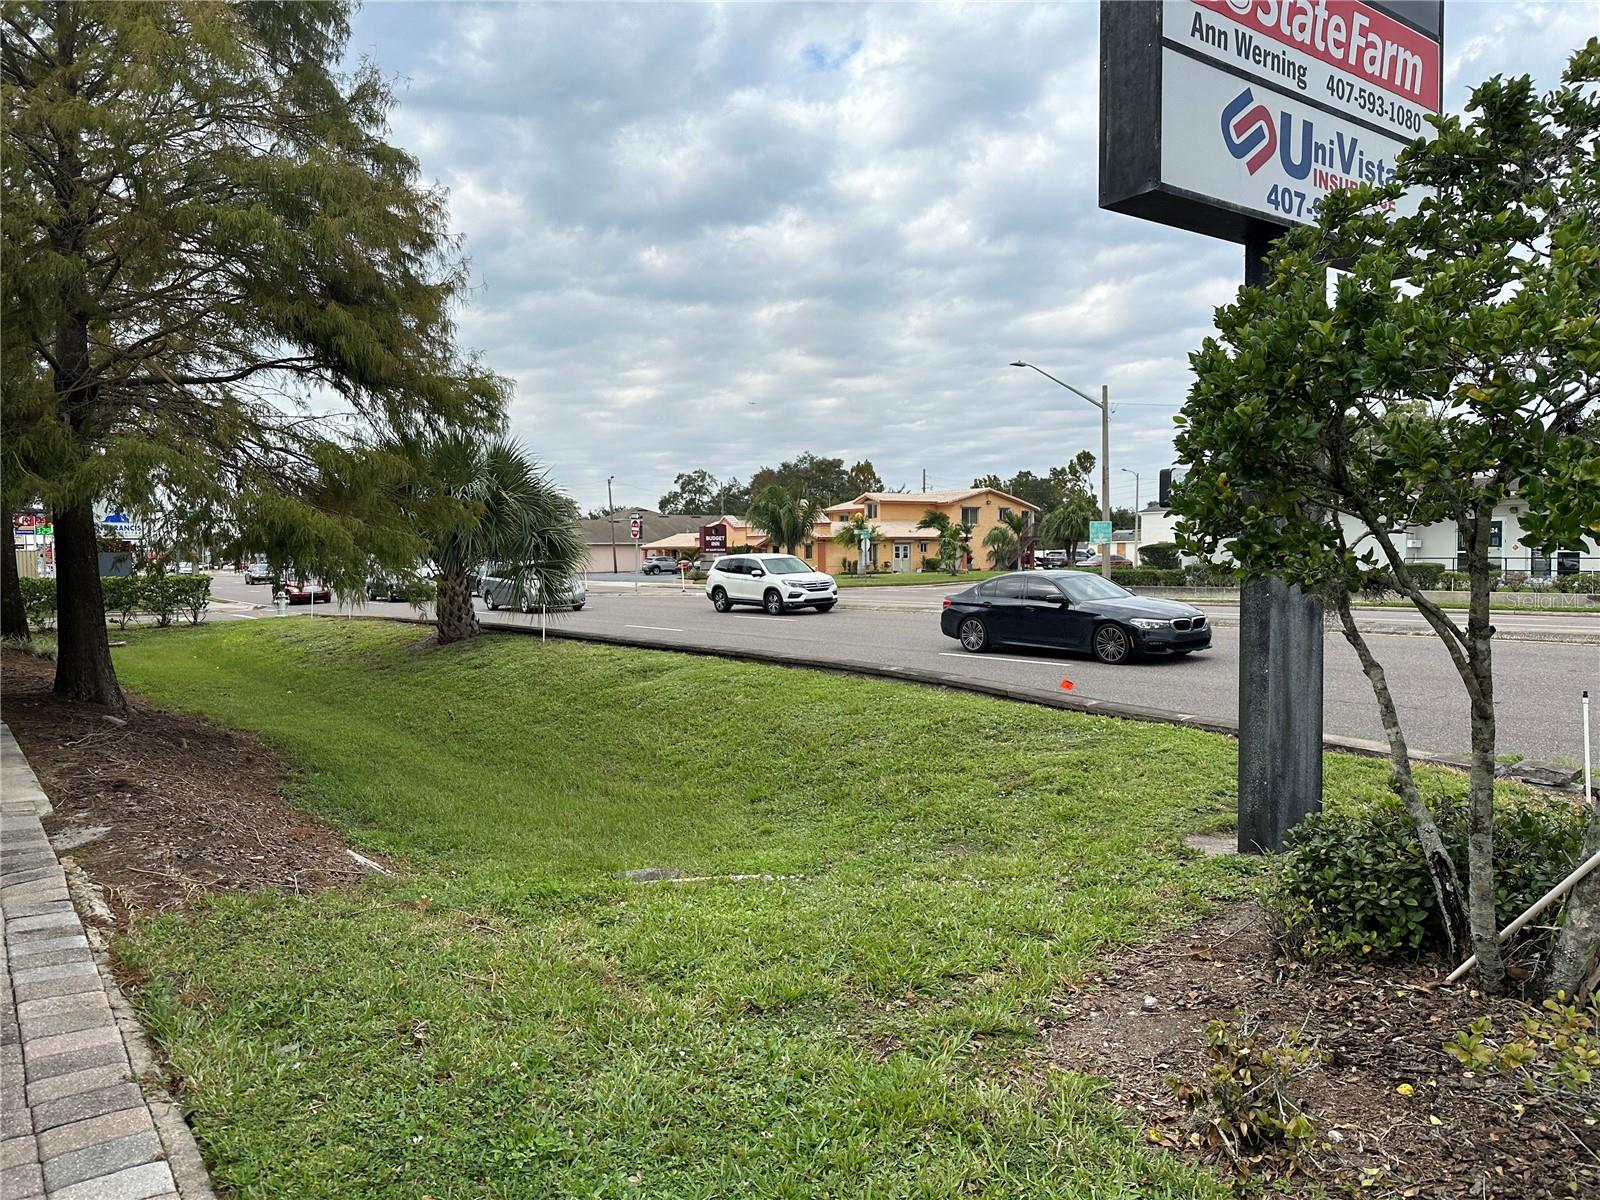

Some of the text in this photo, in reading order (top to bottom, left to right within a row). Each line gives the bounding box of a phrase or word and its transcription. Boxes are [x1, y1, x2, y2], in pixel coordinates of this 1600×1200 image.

[1190, 11, 1308, 90] Ann Werning
[1326, 74, 1421, 133] 407-593-1080
